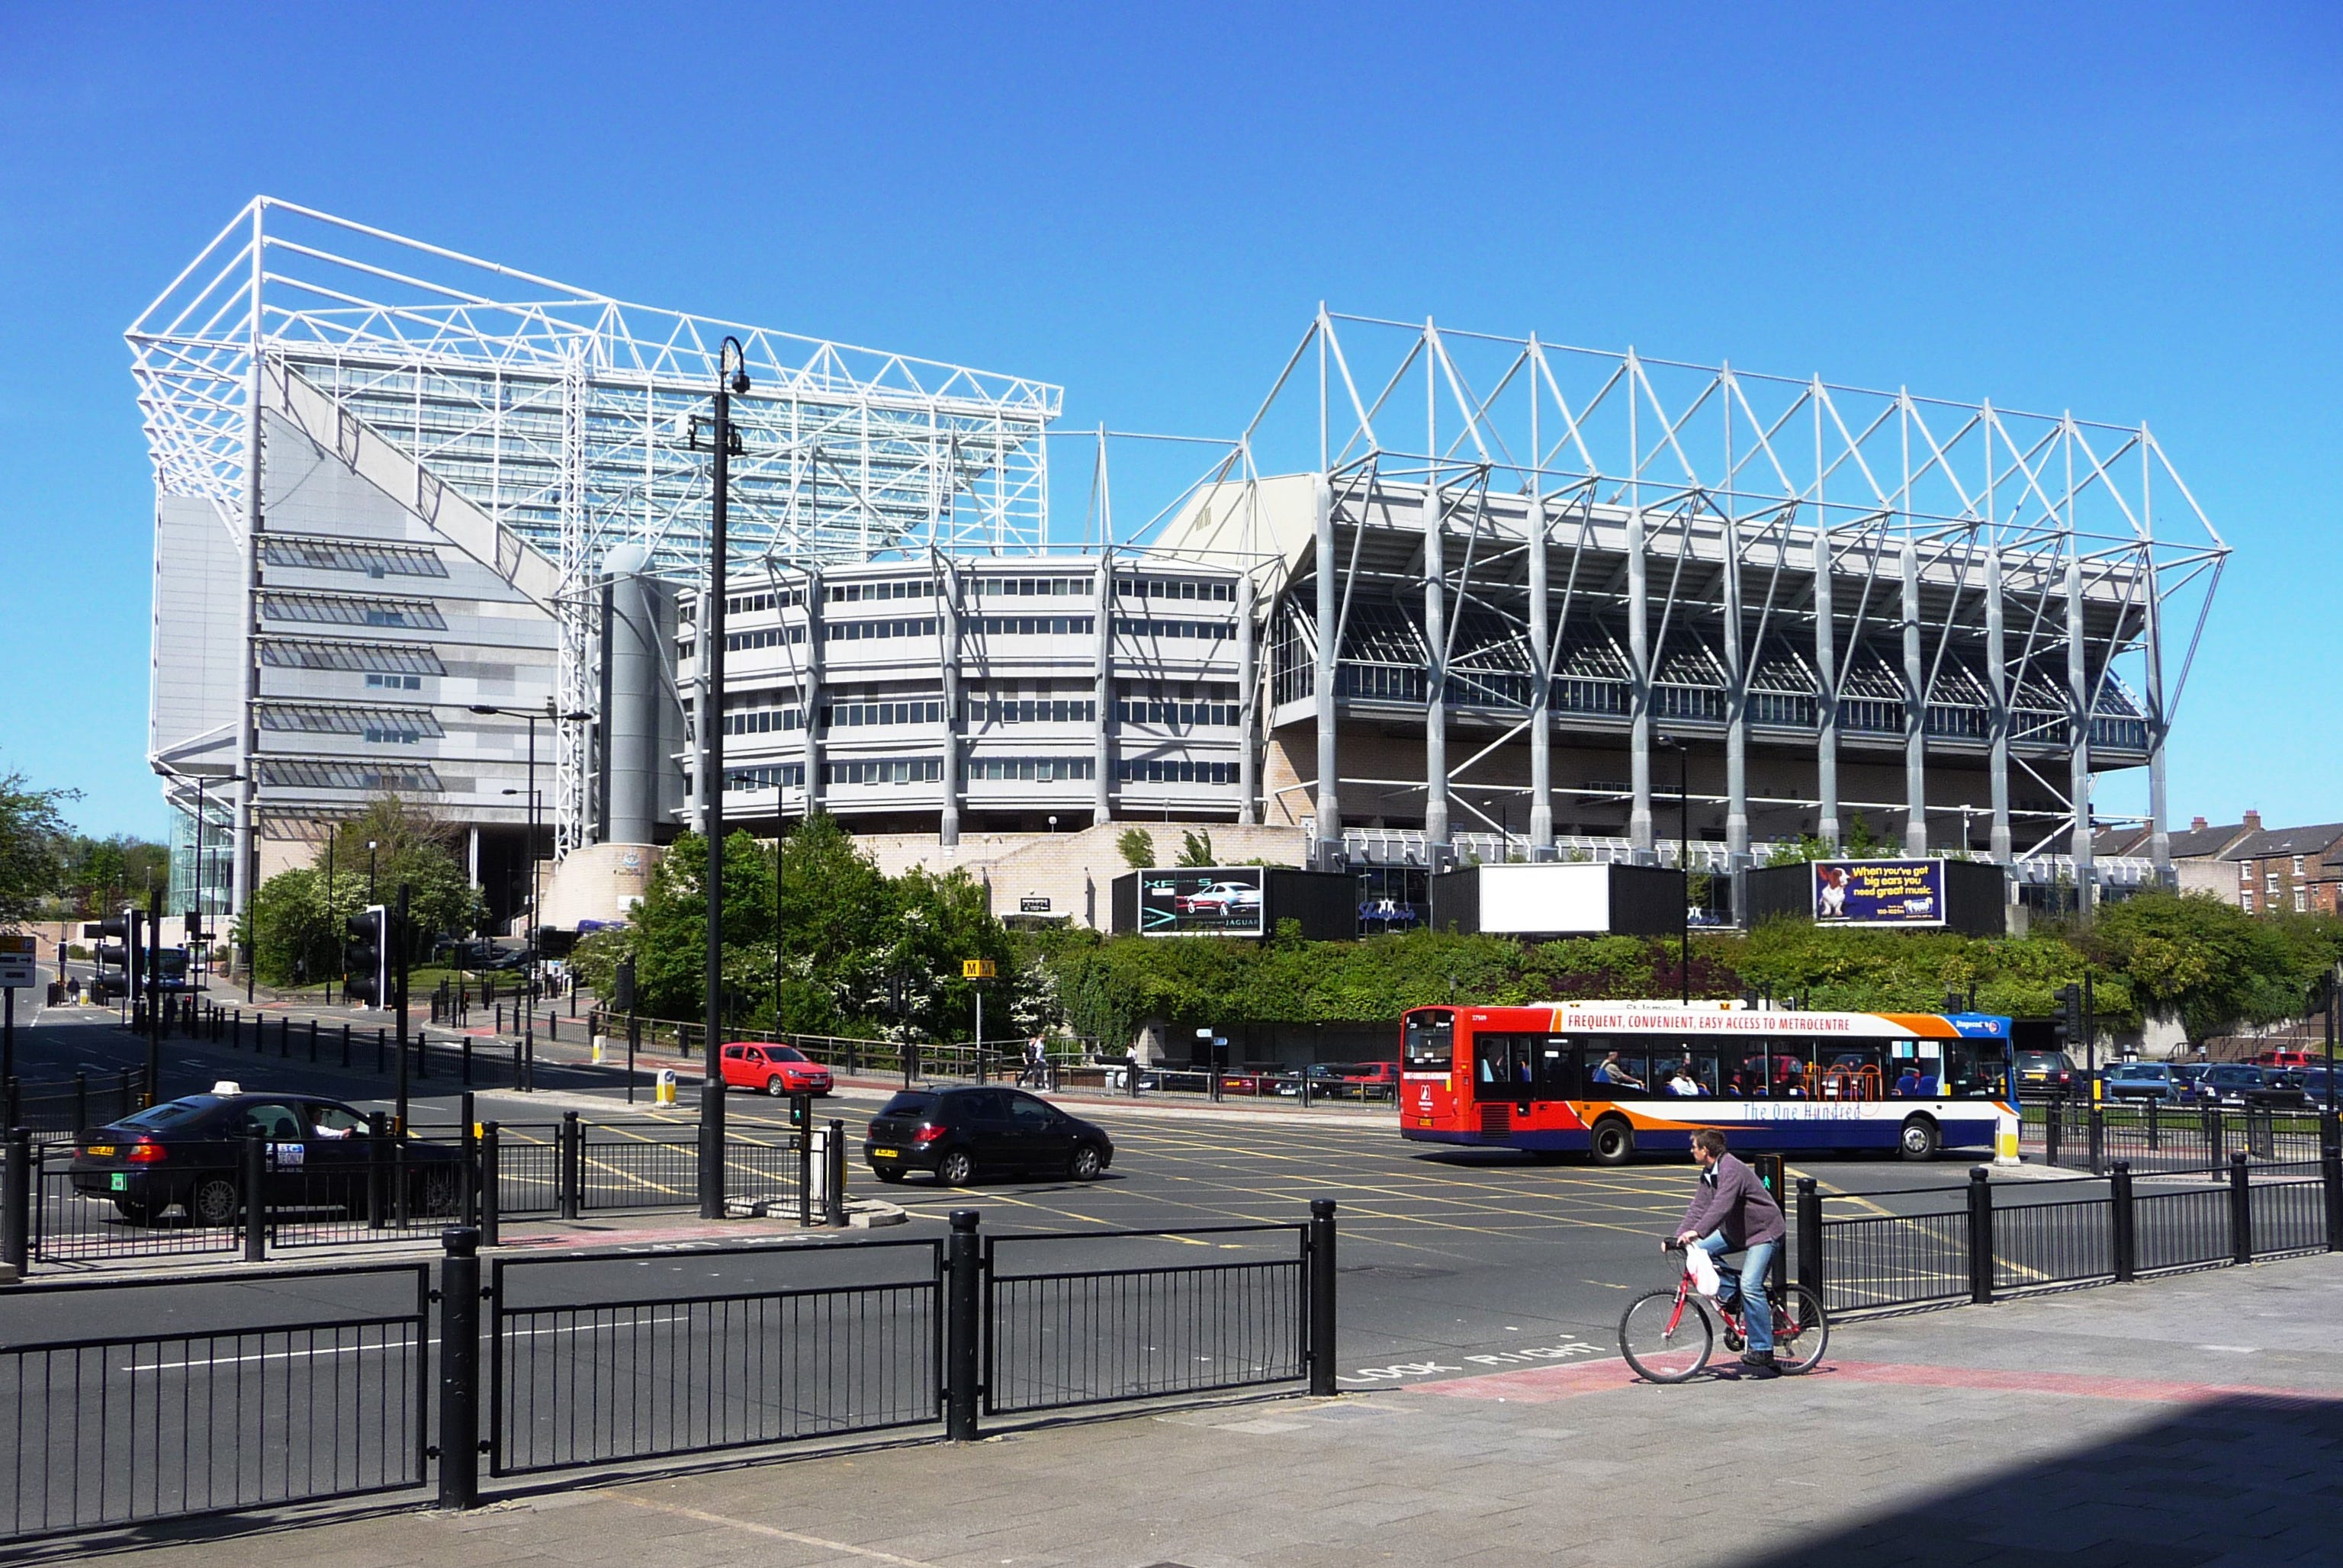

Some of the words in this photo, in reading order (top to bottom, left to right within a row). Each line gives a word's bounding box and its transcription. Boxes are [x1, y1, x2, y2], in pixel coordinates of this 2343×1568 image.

[1852, 867, 1882, 877] When
[1883, 867, 1912, 876] you've
[1913, 866, 1929, 877] got
[1864, 876, 1879, 887] big
[1881, 877, 1903, 885] ears
[1904, 877, 1921, 886] you
[1853, 887, 1875, 896] need
[1876, 886, 1904, 898] great
[967, 963, 976, 975] M
[982, 963, 992, 975] M
[1568, 1015, 1625, 1030] FREQUENT,
[1628, 1015, 1696, 1030] CONVENIENT,
[1699, 1017, 1723, 1029] EASY
[1726, 1017, 1760, 1029] ACCESS
[1763, 1017, 1776, 1029] TO
[1779, 1018, 1850, 1030] METROCENTRE
[1744, 1103, 1767, 1120] The
[1773, 1104, 1798, 1120] One
[1805, 1103, 1861, 1120] Hundred
[1336, 1361, 1463, 1383] LOOK
[1464, 1342, 1606, 1365] RIGHT
